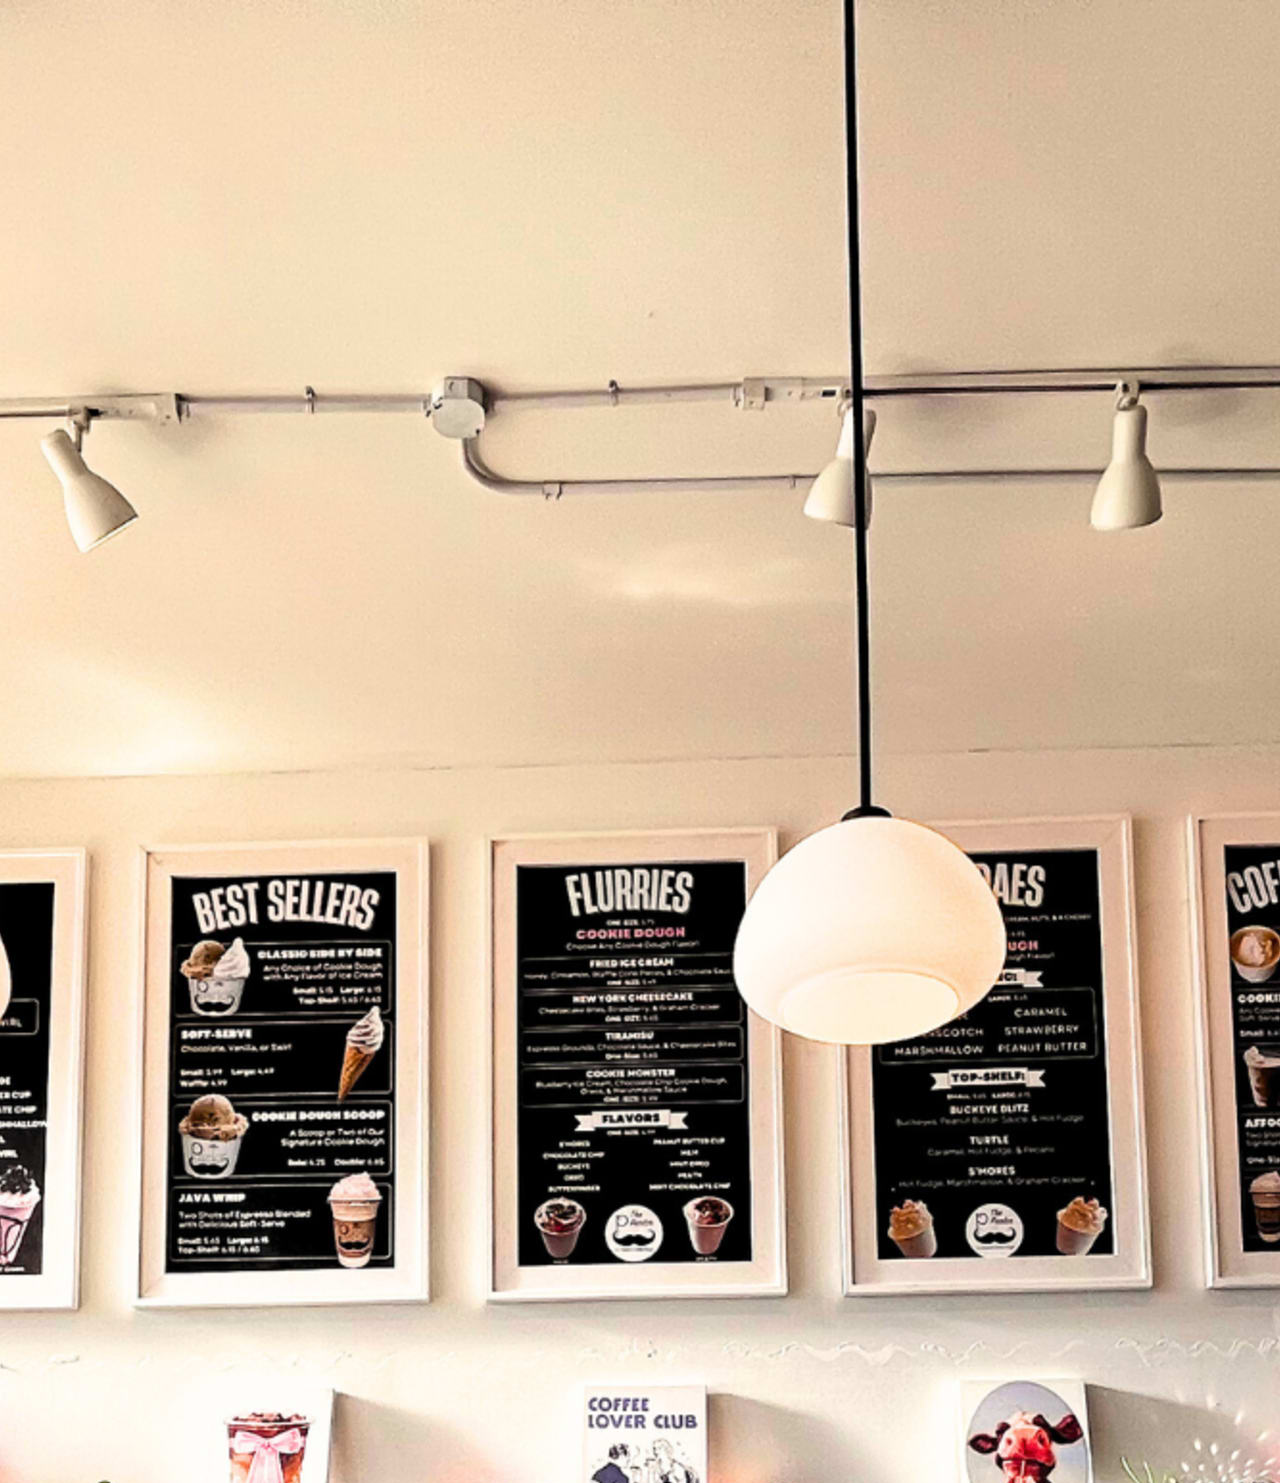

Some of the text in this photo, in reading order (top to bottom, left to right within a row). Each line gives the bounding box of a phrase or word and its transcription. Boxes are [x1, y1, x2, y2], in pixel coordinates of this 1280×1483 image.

[565, 869, 694, 916] FLURRIES
[193, 880, 379, 934] BEST SELLERS
[576, 927, 685, 939] COOKIE DOUGH
[258, 949, 382, 959] CLASSIC SIDE BY SIDE
[590, 958, 673, 968] FRIED ICE CREAM
[573, 993, 693, 1004] NEW YORK CHEESECAKE
[1014, 1008, 1067, 1018] CARAMEL
[181, 1029, 252, 1039] SOFT-SERVE
[1005, 1025, 1079, 1036] STRAWBERRY
[895, 1045, 984, 1056] MARSHMALLOW
[998, 1042, 1086, 1053] PEANUT BUTTER
[586, 1069, 675, 1078] COOKIE MONSTER
[950, 1104, 1029, 1115] BUCKEYE BLITZ
[252, 1111, 385, 1122] COOKIE DOUGH SCOOP
[602, 1113, 660, 1124] FLAVORS
[970, 1136, 1009, 1144] TURTLE
[179, 1193, 246, 1203] JAVA WHIP
[588, 1397, 650, 1412] COFFEE
[588, 1415, 697, 1429] LOVER CLUB
